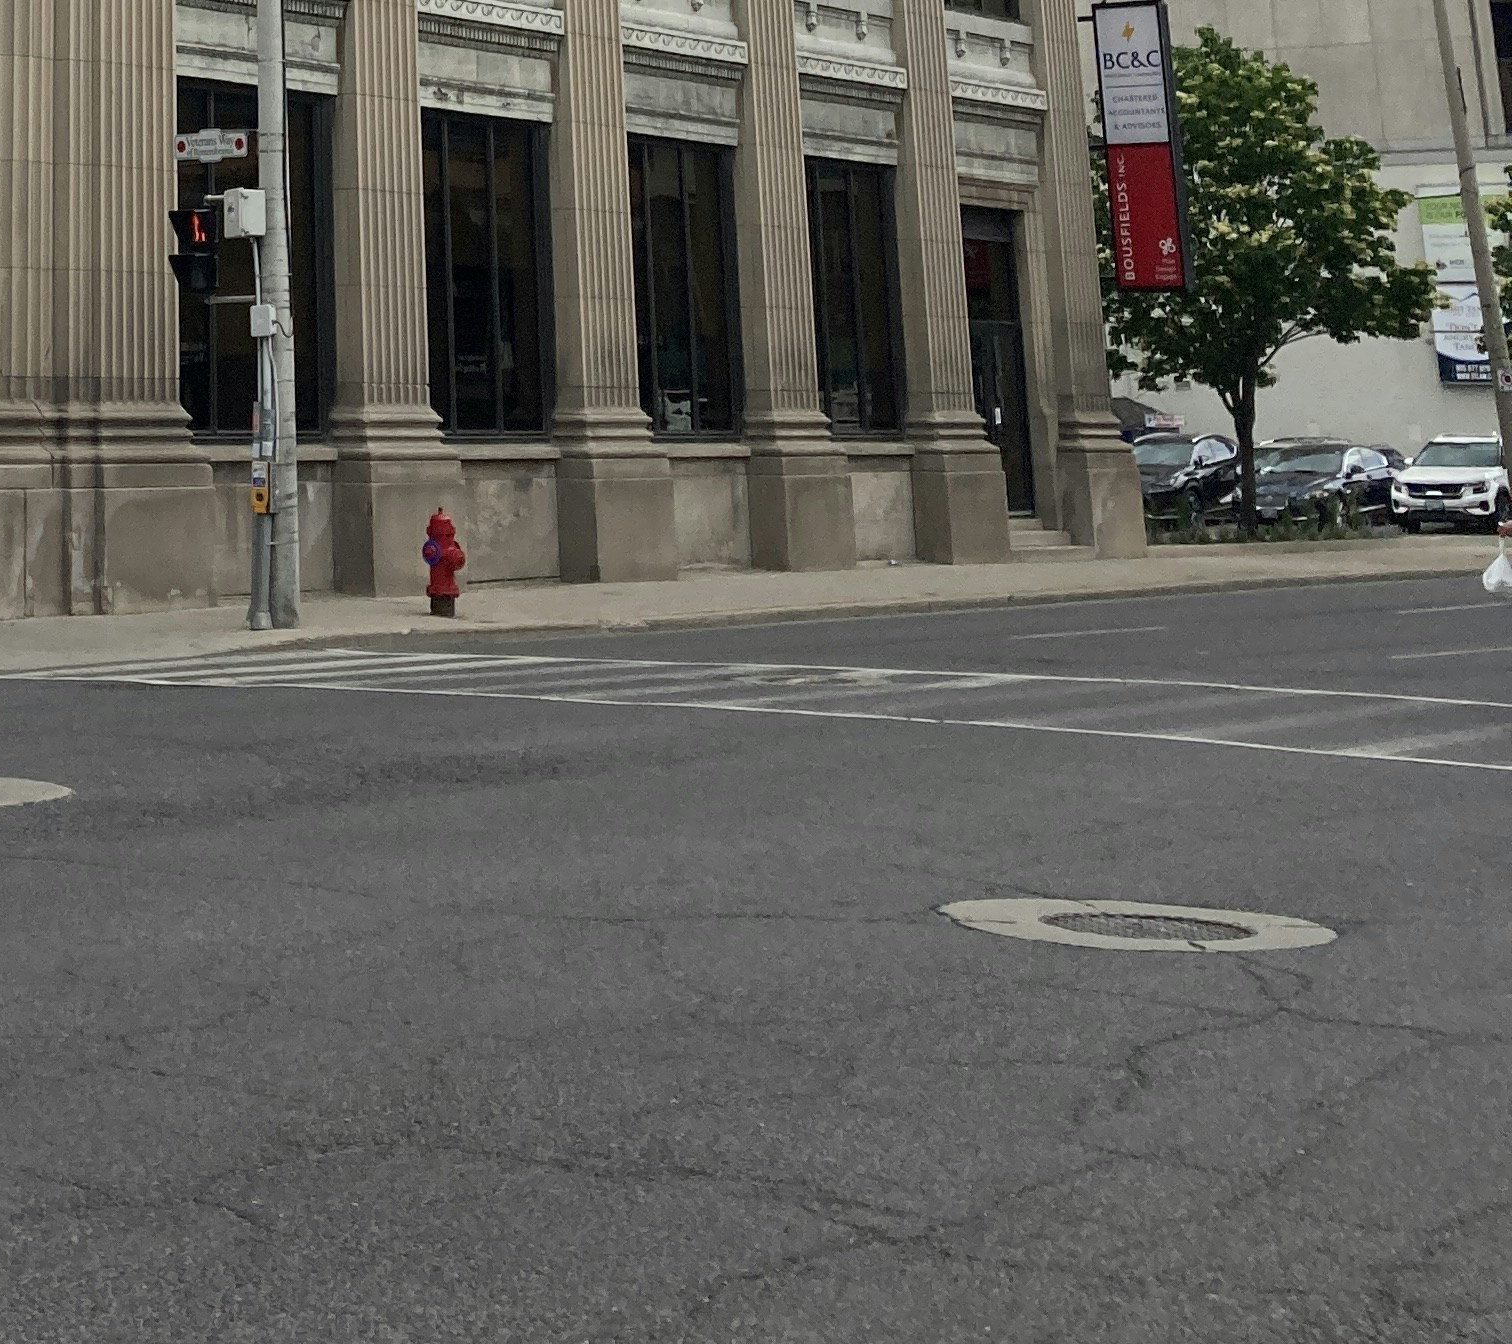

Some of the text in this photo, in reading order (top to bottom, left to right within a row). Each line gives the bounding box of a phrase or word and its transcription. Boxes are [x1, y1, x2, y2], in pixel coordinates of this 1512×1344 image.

[1102, 49, 1161, 70] BC&C
[1112, 94, 1158, 103] CHARTERED
[186, 133, 234, 148] Veterans Way
[1116, 182, 1136, 281] BOUSFIELDS
